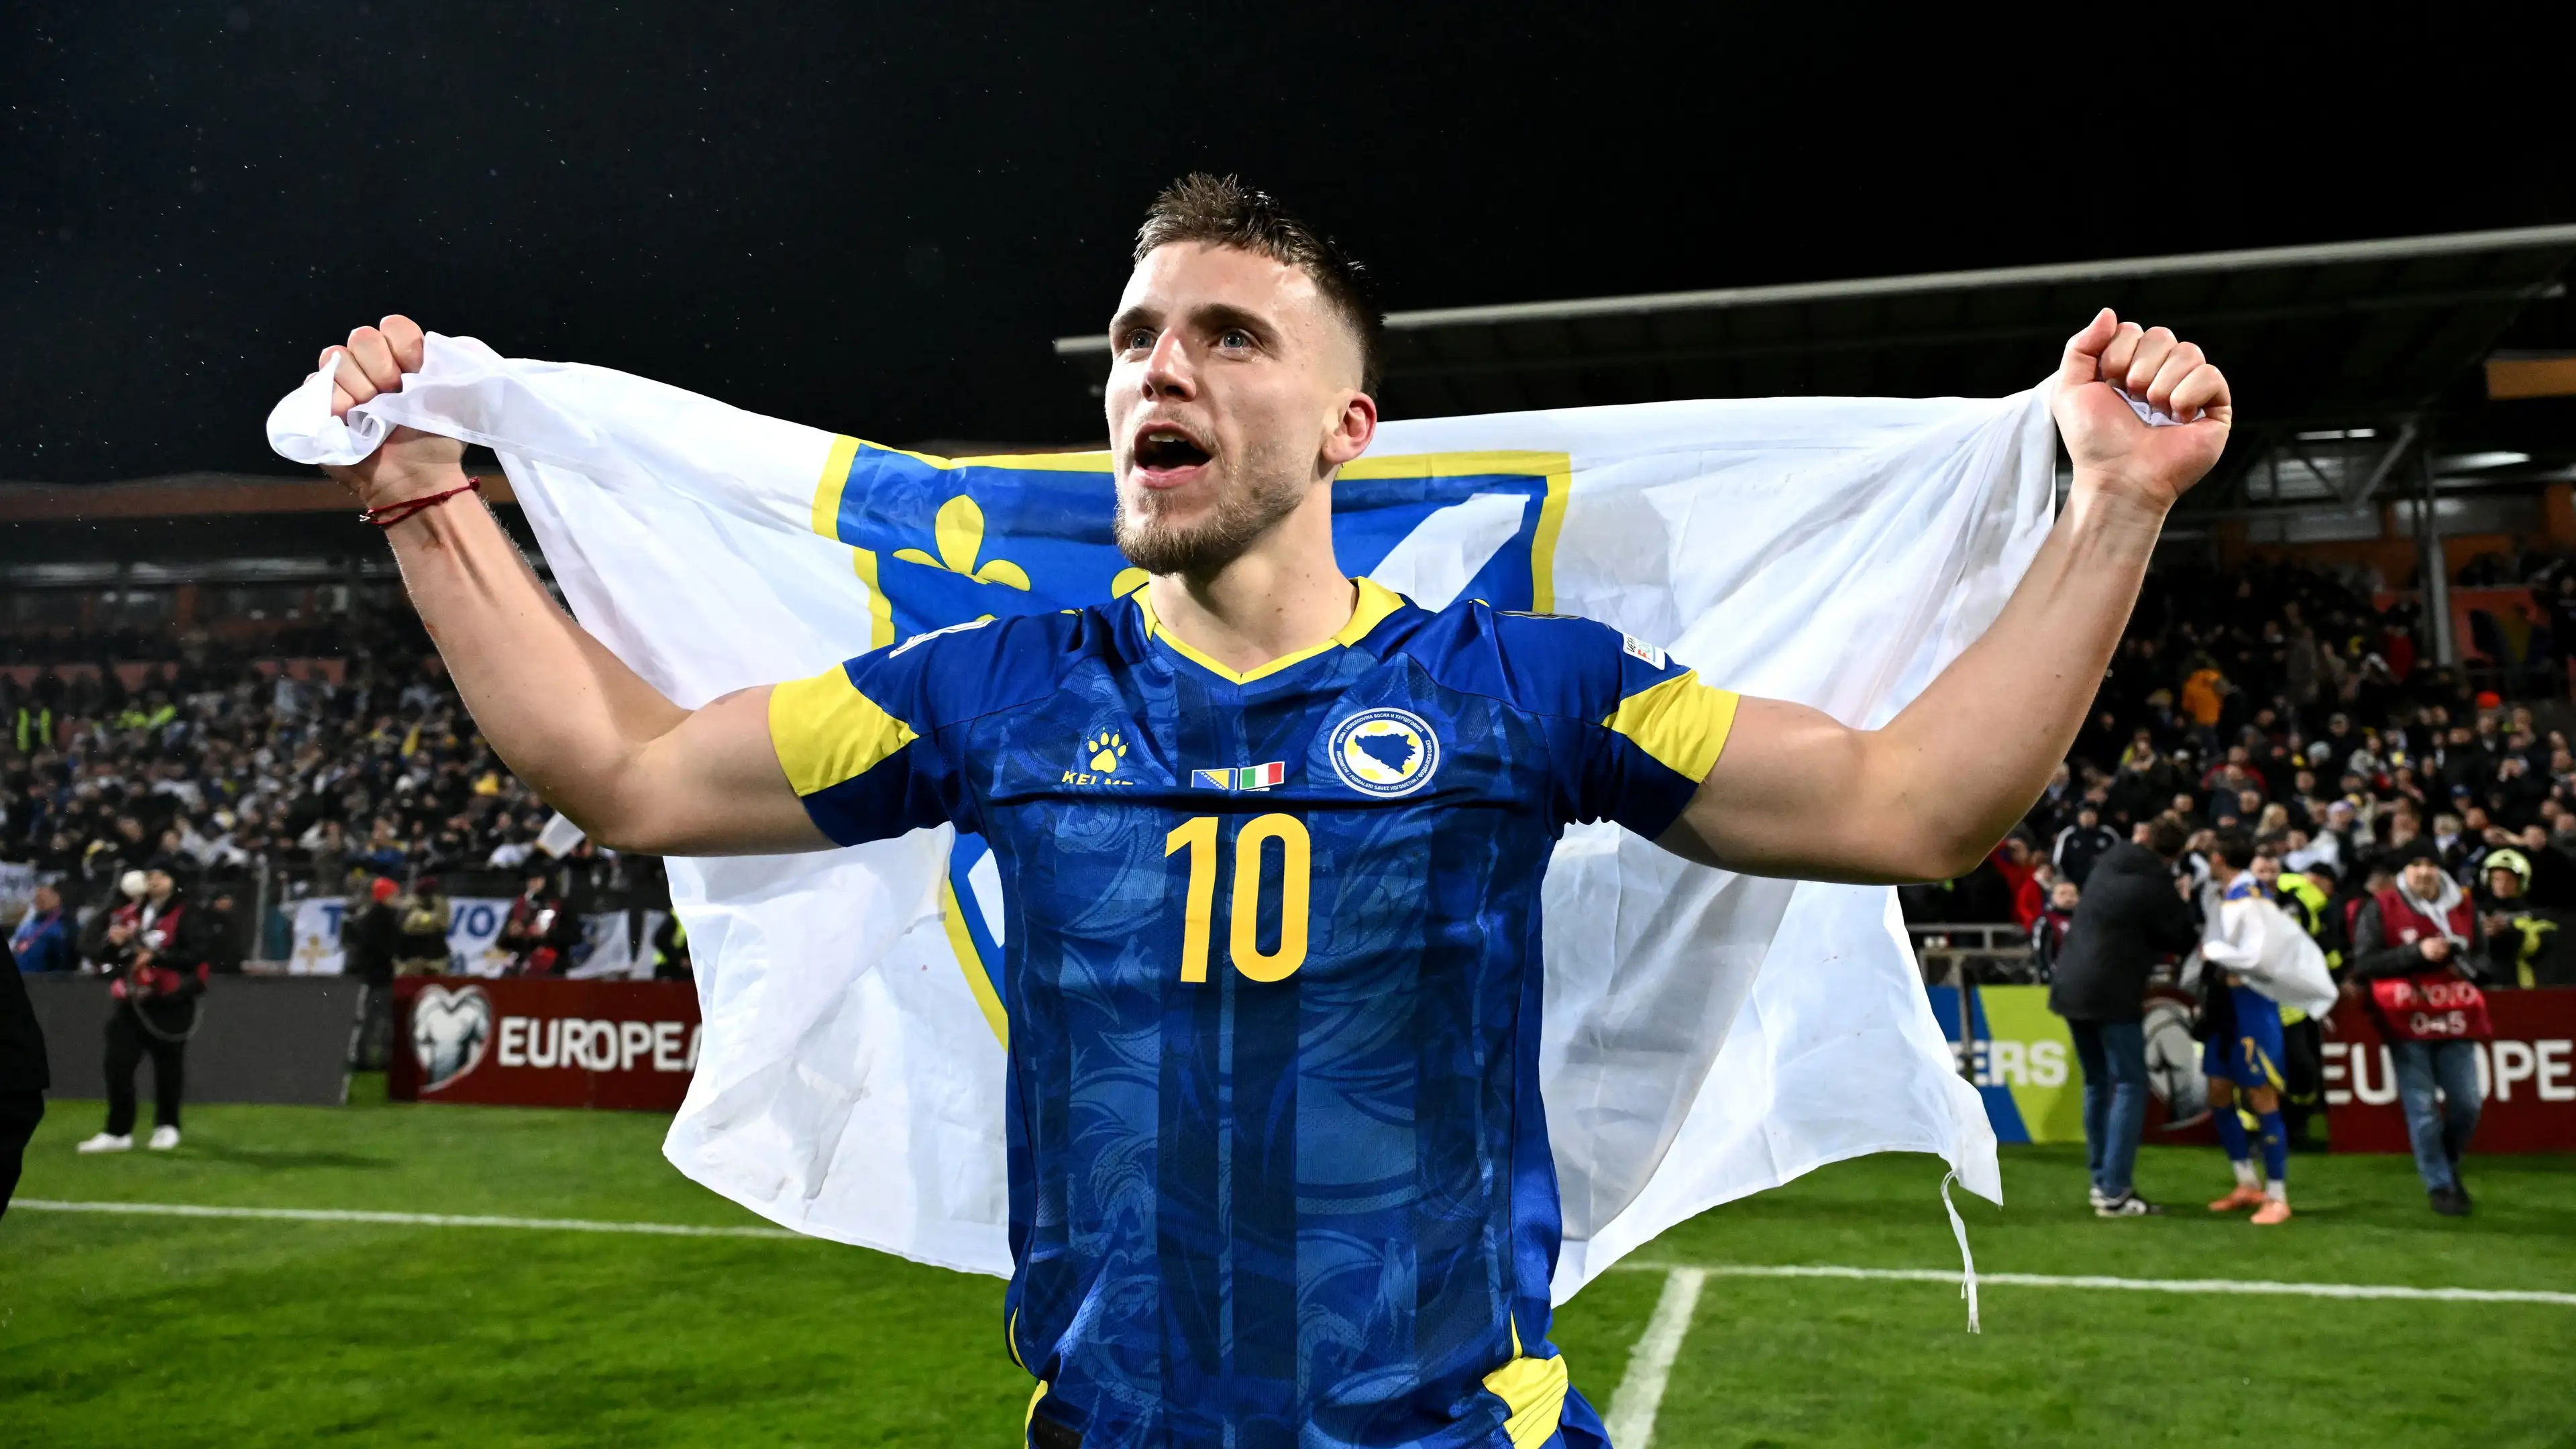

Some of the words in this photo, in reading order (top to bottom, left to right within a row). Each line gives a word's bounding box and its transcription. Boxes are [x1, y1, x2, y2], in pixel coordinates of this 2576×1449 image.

[1346, 714, 1373, 731] HERCEGOVINA
[1395, 714, 1424, 733] ХЕРЦЕГОВИНА
[1350, 775, 1373, 789] FUDBALSKI
[1391, 778, 1416, 791] НОГОМЕТНИ
[1165, 813, 1311, 983] 10
